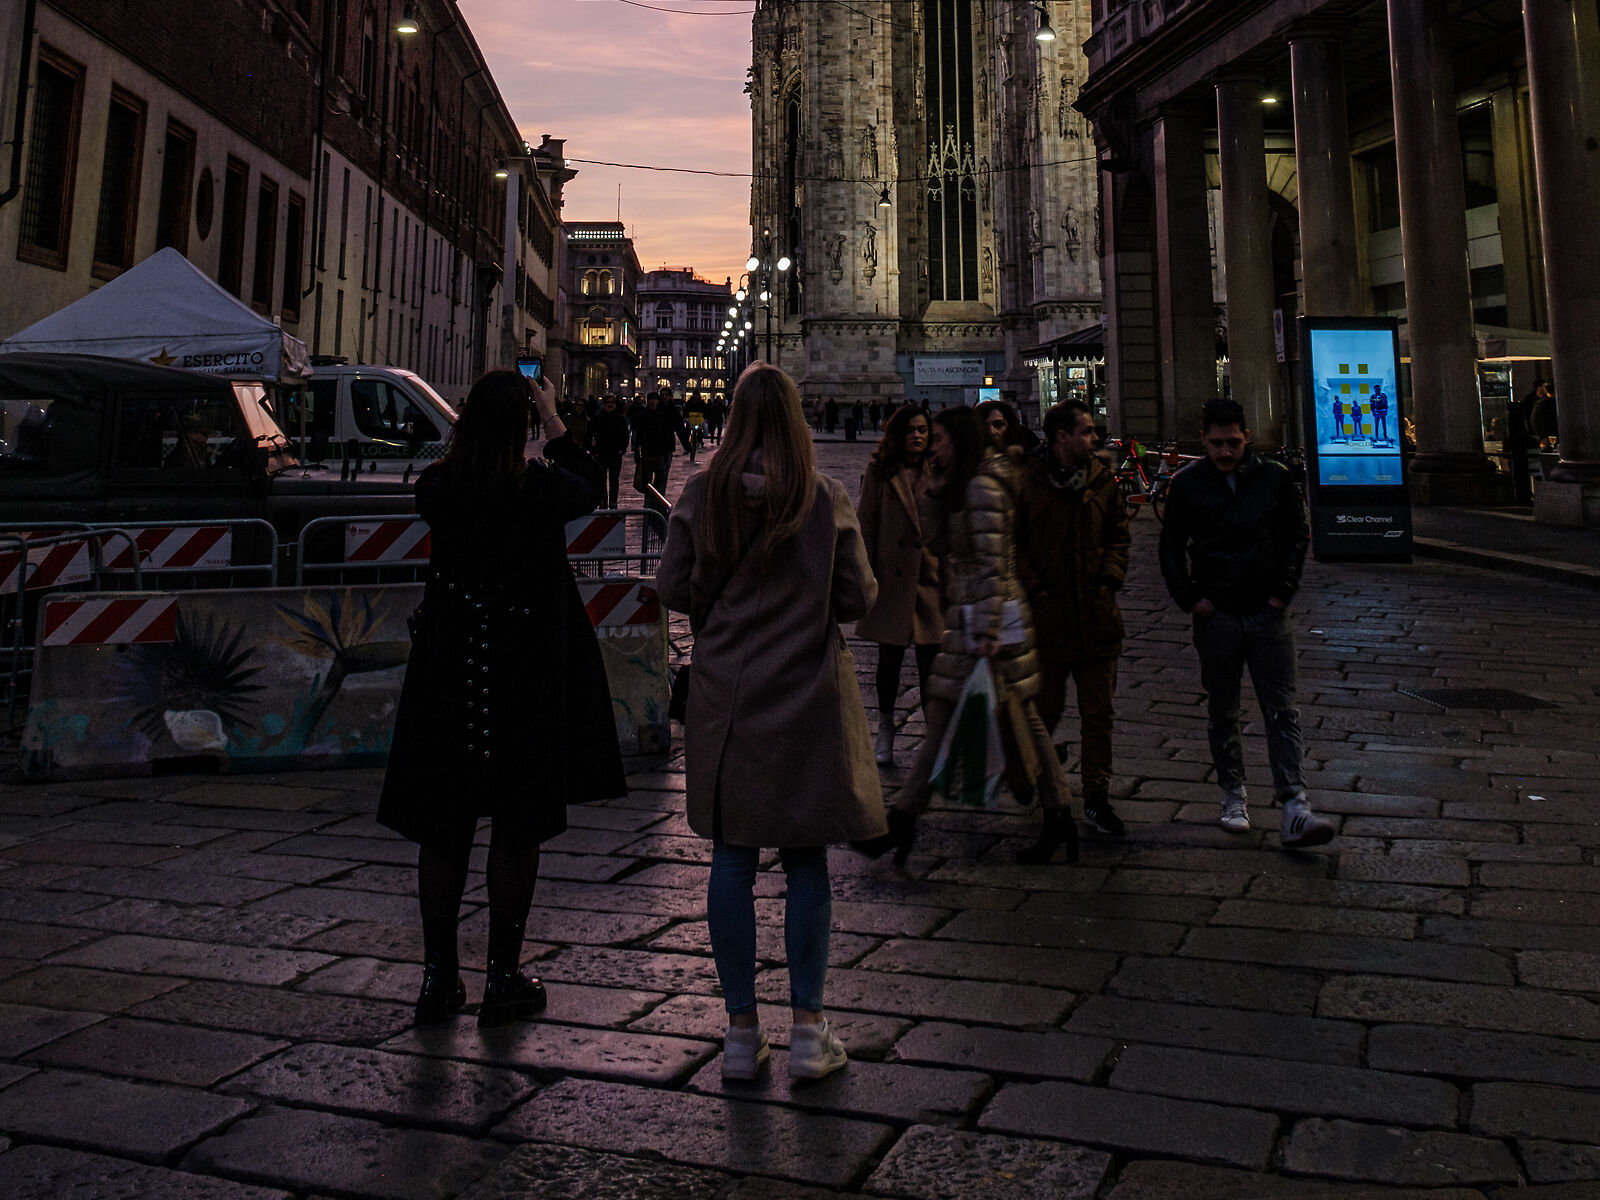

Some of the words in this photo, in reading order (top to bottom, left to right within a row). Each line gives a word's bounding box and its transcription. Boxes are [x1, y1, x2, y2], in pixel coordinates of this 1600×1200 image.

[183, 352, 264, 367] ESERCITO
[361, 445, 409, 456] LOCALE
[1346, 515, 1364, 523] Clear
[1365, 515, 1393, 523] Channel
